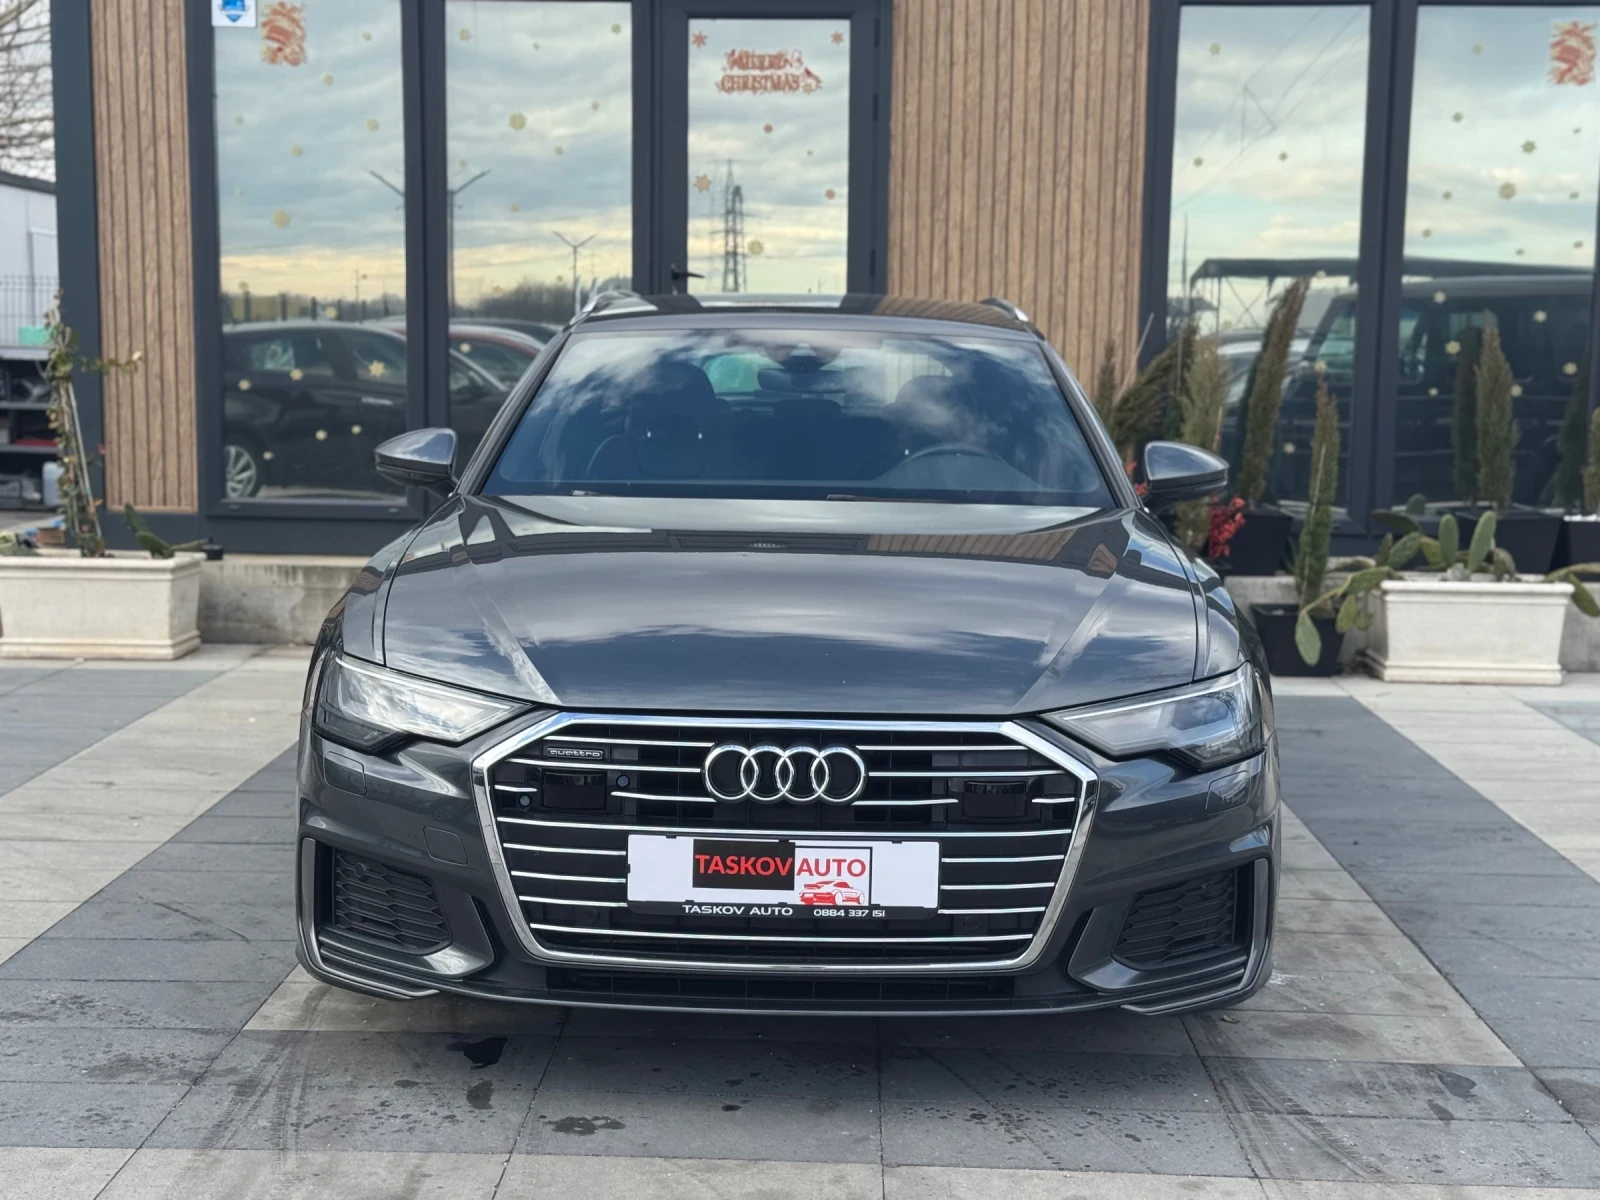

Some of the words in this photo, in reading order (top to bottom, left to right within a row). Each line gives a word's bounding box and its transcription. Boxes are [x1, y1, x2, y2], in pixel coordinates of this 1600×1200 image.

[721, 74, 801, 92] CHRISTMAS
[695, 854, 793, 876] TASKOV
[796, 858, 867, 877] AUTO
[682, 904, 745, 915] TASKOV
[751, 906, 793, 917] AUTO
[813, 908, 845, 917] 0884
[848, 909, 869, 918] 337
